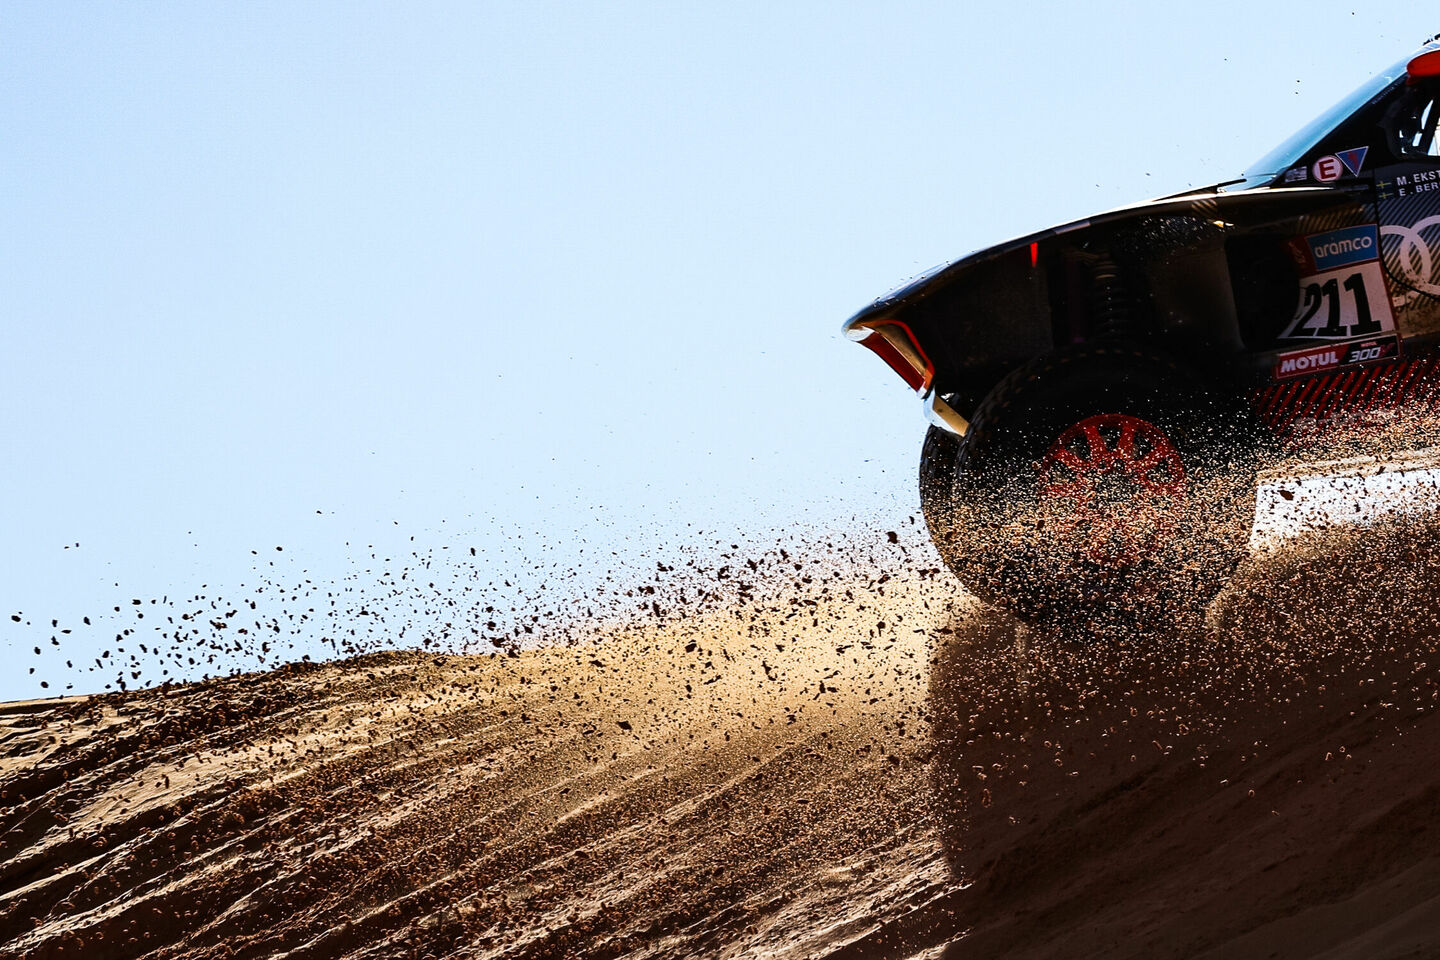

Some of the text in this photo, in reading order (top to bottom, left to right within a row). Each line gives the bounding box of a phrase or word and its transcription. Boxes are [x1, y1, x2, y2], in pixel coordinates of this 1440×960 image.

[1319, 159, 1336, 179] E
[1314, 236, 1373, 258] aramco
[1288, 273, 1382, 337] 211
[1280, 351, 1339, 373] MOTUL
